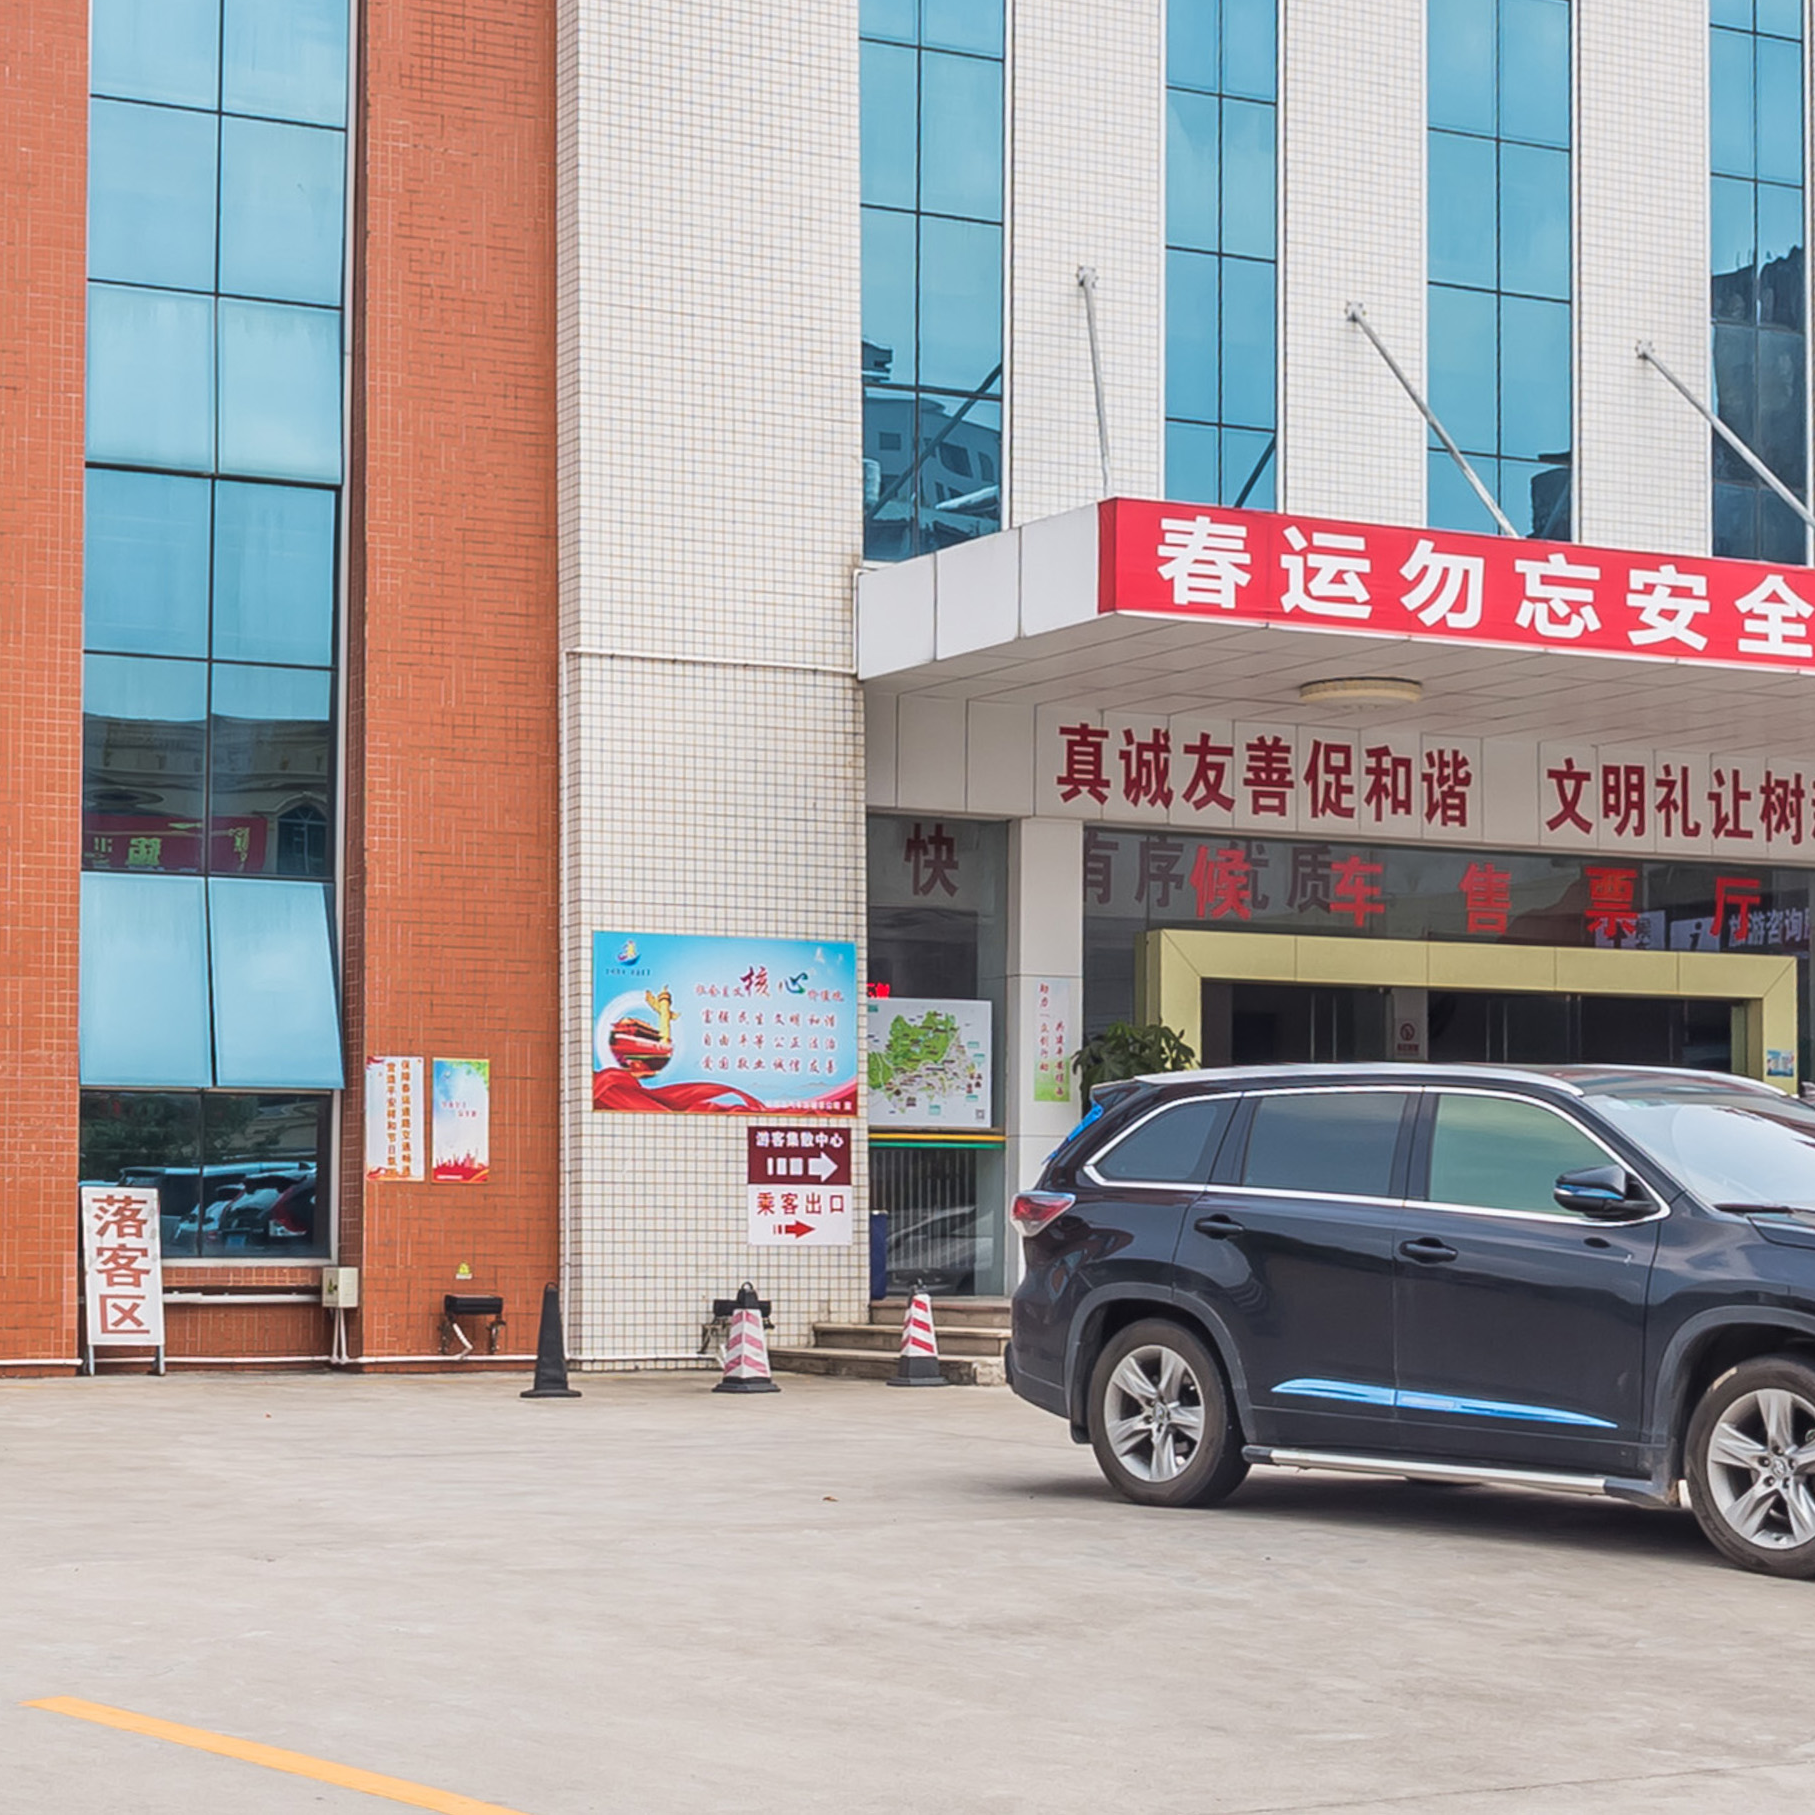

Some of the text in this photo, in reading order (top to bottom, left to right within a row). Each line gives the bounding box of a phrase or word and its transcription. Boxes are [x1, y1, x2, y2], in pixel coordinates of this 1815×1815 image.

[1156, 515, 1815, 658] 春运勿忘安全
[1057, 723, 1472, 827] 真诚友善促和谐
[904, 823, 959, 897] 快
[1190, 845, 1761, 940] 候车售票厅
[756, 1192, 844, 1215] 乘客出口
[91, 1195, 151, 1335] 落客区
